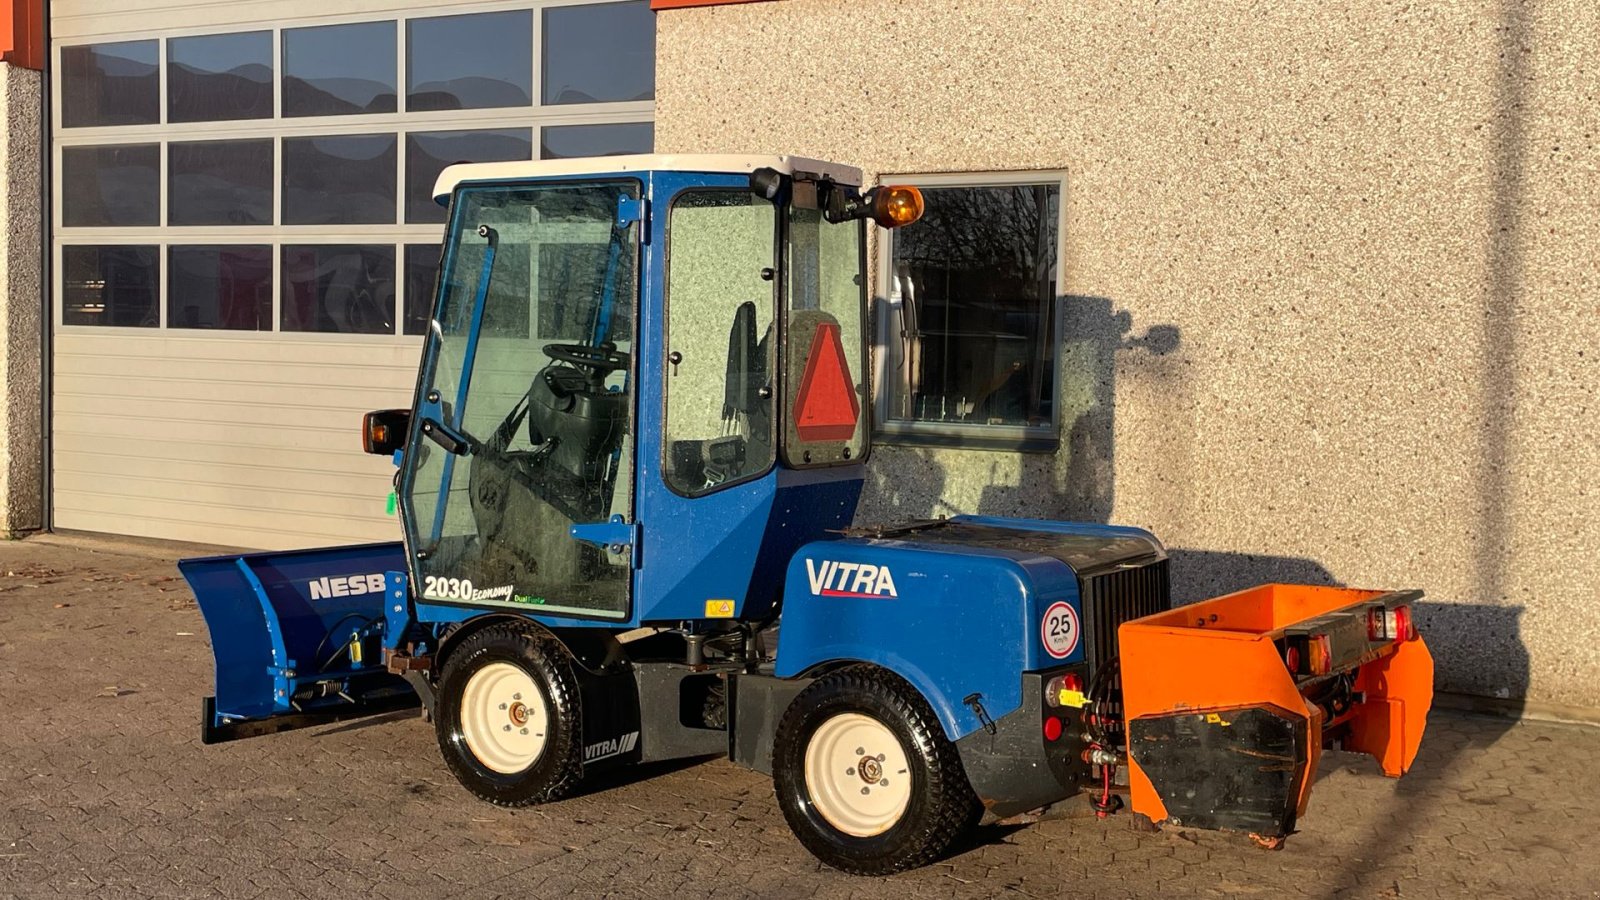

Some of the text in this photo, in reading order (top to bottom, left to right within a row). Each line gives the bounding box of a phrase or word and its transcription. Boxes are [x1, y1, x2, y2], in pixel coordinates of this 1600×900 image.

[309, 573, 387, 600] NESB
[424, 576, 514, 602] 2030 Economy
[806, 558, 898, 596] VITRA
[1050, 613, 1071, 637] 25
[585, 738, 618, 760] VITRA
